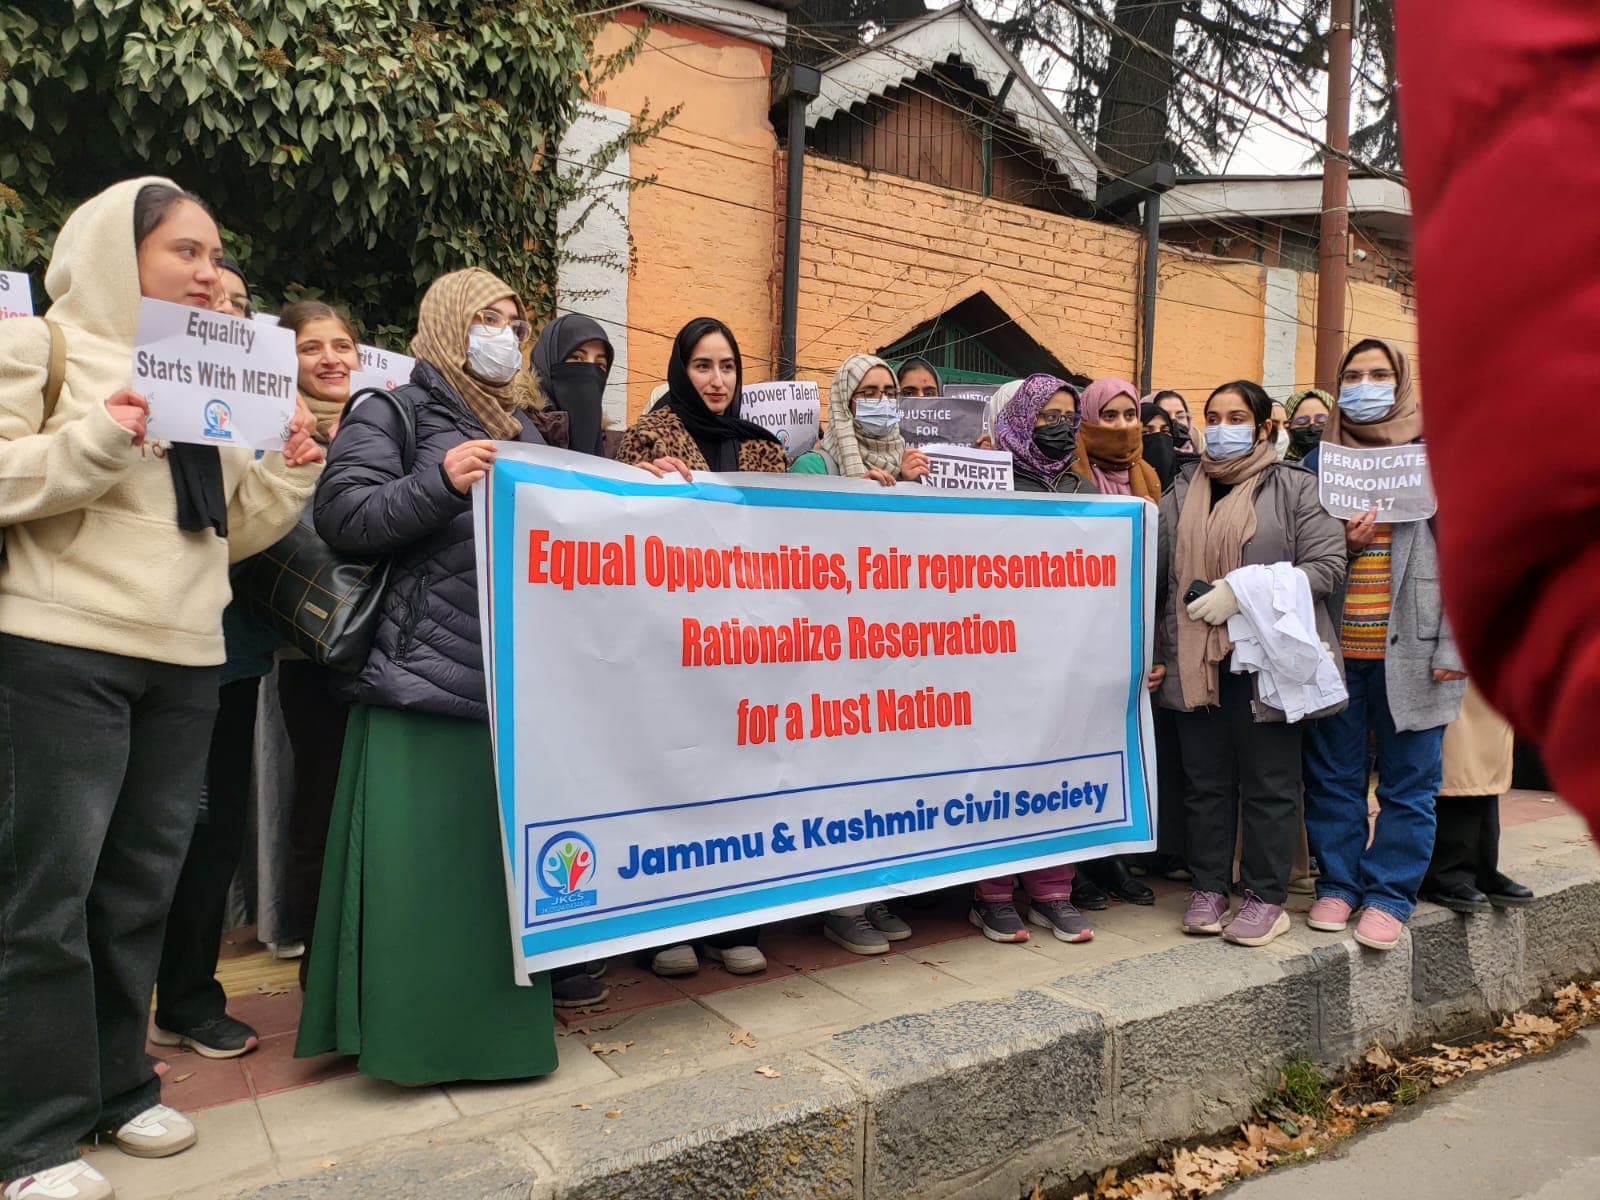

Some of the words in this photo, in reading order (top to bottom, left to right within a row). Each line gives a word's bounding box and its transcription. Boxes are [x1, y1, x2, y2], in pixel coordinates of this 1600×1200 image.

[186, 311, 256, 354] Equality
[137, 350, 192, 385] Starts
[198, 361, 238, 391] With
[242, 369, 293, 400] MERIT
[789, 384, 819, 401] Talent
[789, 408, 813, 426] Merit
[898, 409, 952, 421] #JUSTICE
[917, 426, 939, 437] FOR
[929, 461, 950, 475] ET
[954, 463, 1008, 481] MERIT
[1323, 452, 1427, 471] #ERADICATE
[1324, 471, 1422, 491] DRACONIAN
[1329, 493, 1370, 512] RULE
[1376, 497, 1396, 511] 17
[528, 529, 636, 590] Equal
[644, 535, 852, 594] Opportunities,
[857, 546, 911, 589] Fair
[918, 548, 1117, 593] representation
[681, 617, 842, 667] Rationalize
[848, 614, 1016, 660] Reservation
[737, 698, 778, 746] for
[785, 701, 804, 740] a
[810, 693, 871, 738] Just
[877, 687, 972, 732] Nation
[618, 831, 764, 880] Jammu
[770, 822, 797, 854] &
[802, 799, 939, 849] Kashmir
[944, 787, 1010, 827] Civil
[1015, 781, 1109, 816] Society
[551, 893, 584, 905] JKCS
